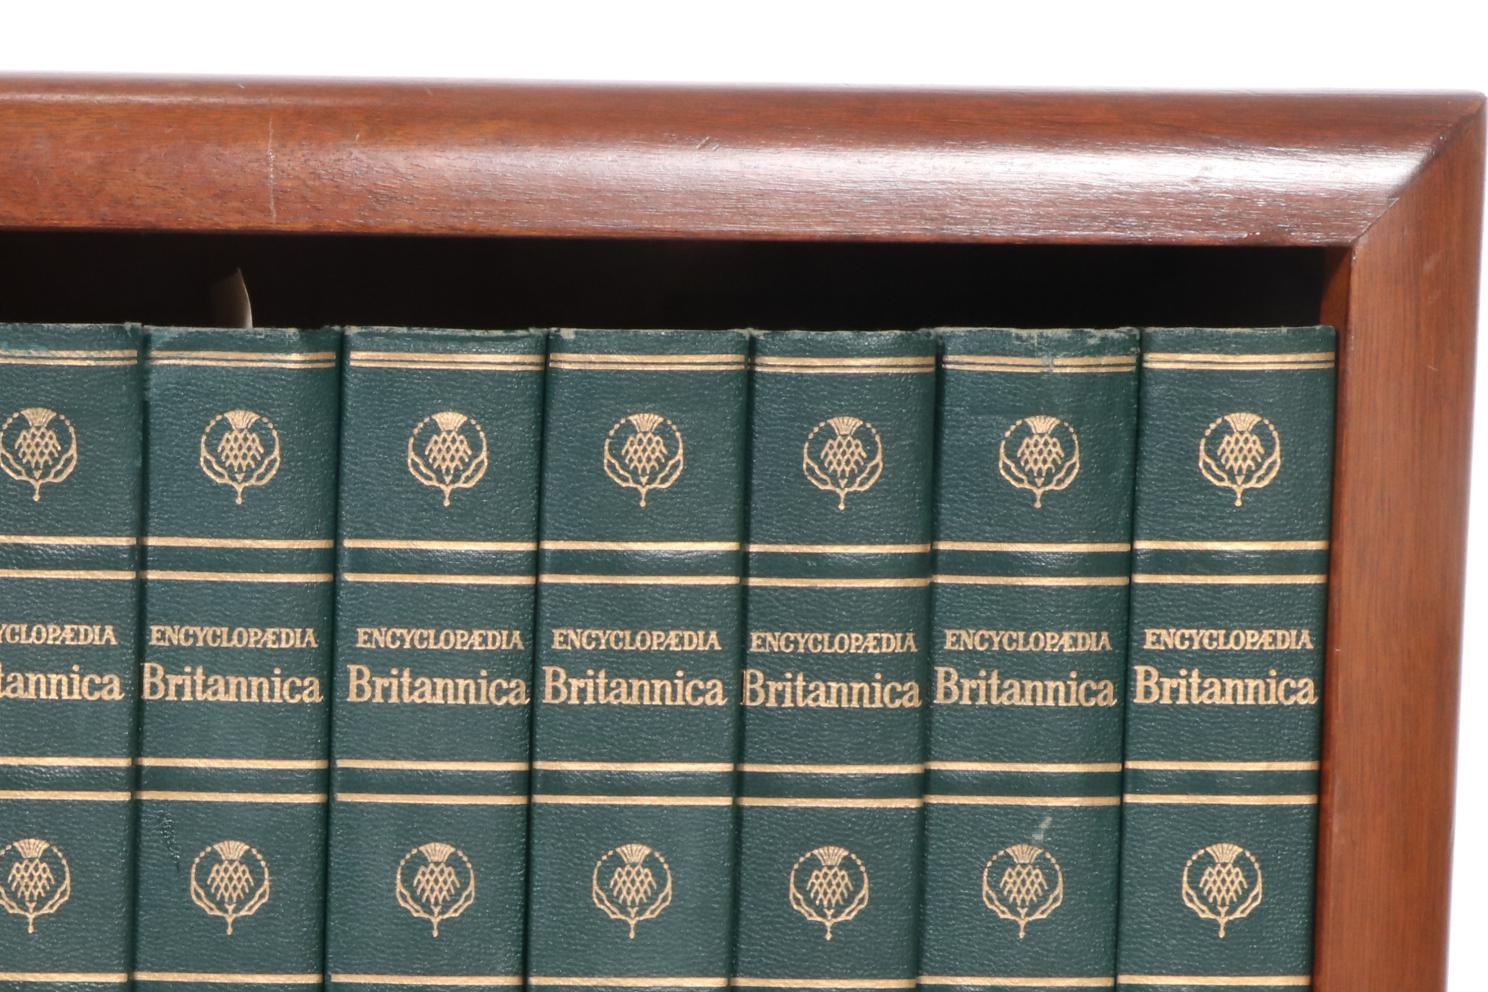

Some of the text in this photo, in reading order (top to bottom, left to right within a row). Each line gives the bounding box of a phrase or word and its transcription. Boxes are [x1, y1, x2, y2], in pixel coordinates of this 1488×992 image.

[142, 661, 324, 704] Britannica
[347, 663, 531, 706] Britannica
[543, 665, 728, 707] Britannica
[742, 667, 923, 709] Britannica
[934, 666, 1118, 708] Britannica
[1133, 664, 1319, 706] Britannica
